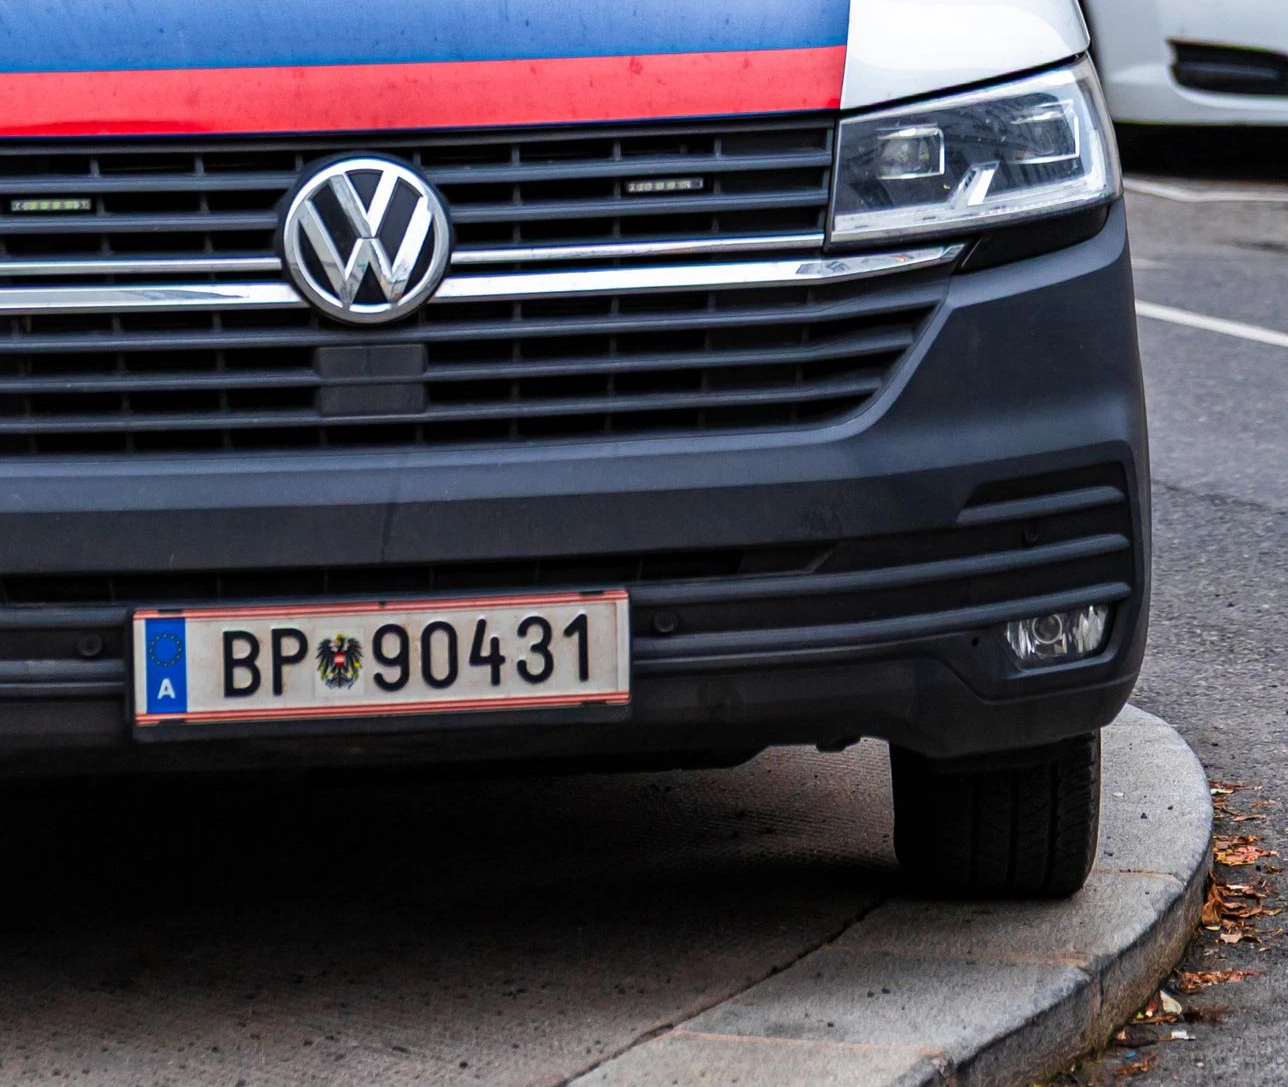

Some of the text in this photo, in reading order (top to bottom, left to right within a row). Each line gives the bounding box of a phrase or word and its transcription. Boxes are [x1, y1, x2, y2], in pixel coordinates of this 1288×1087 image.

[287, 161, 447, 320] VW
[157, 612, 590, 700] A BP 90431
